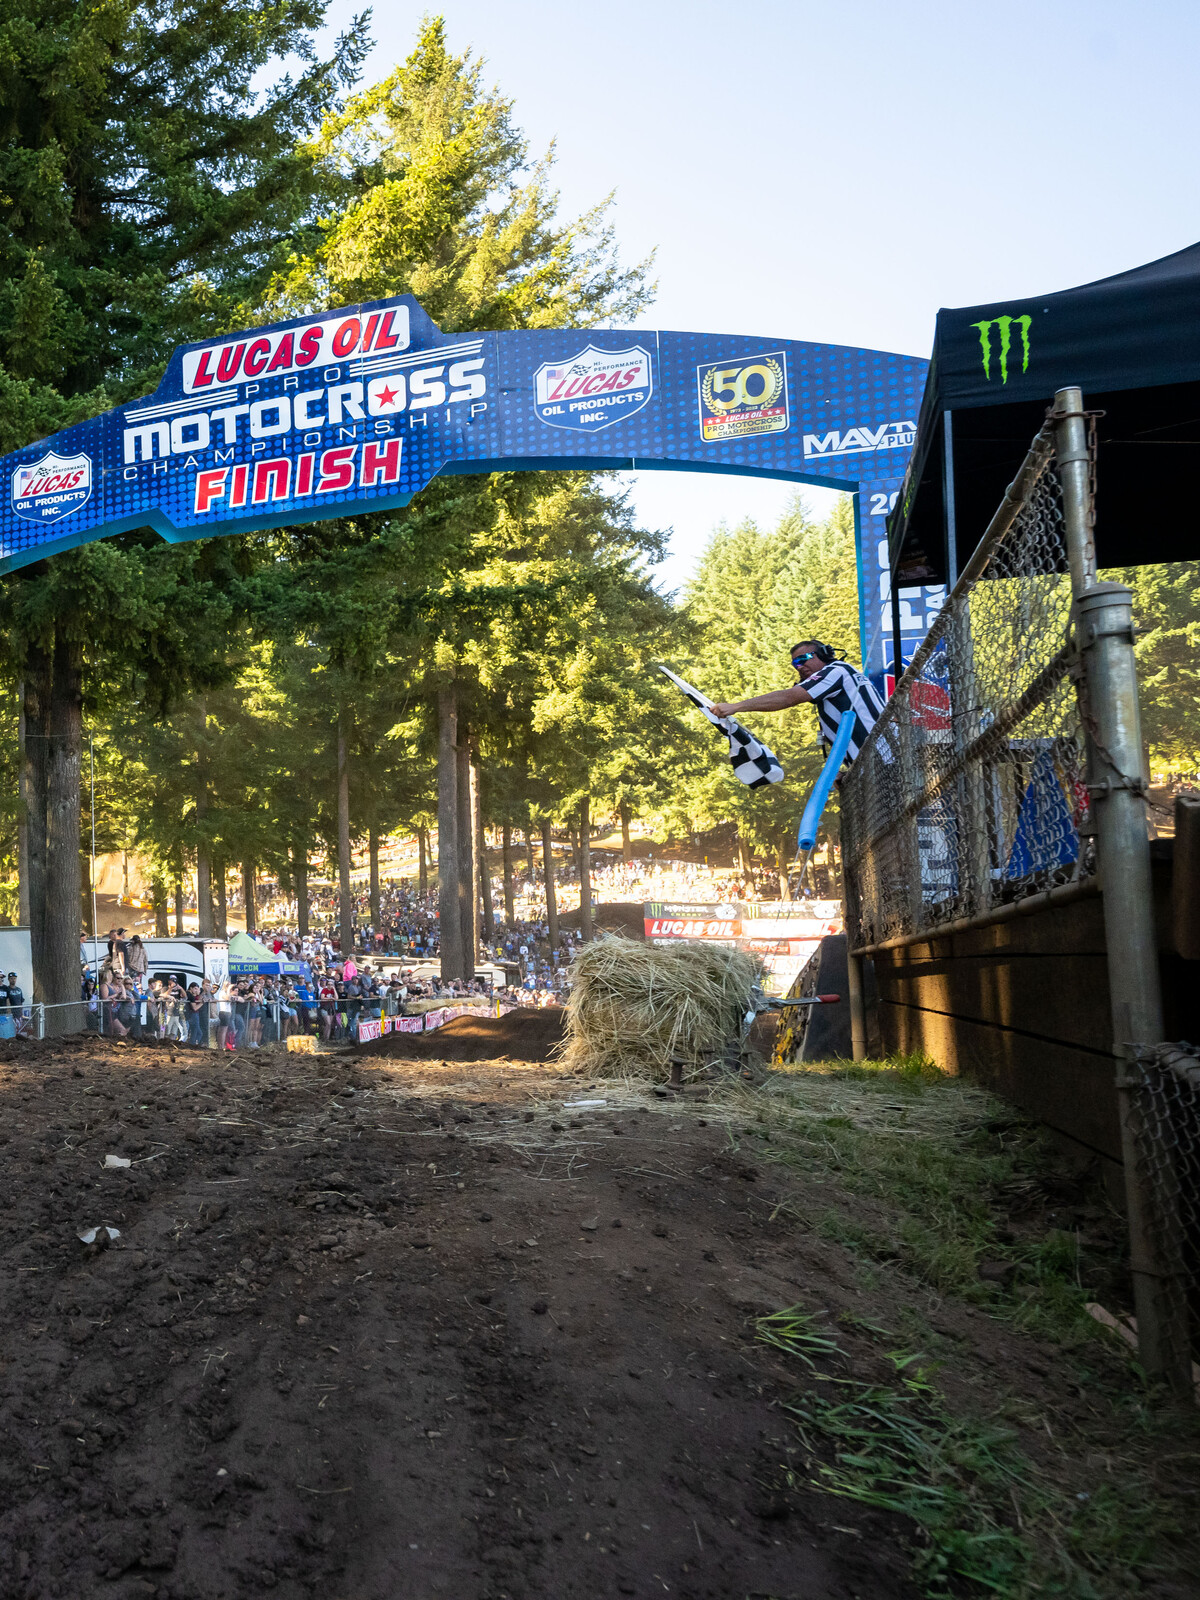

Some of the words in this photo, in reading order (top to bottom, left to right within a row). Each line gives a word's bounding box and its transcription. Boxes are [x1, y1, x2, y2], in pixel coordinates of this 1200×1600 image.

[192, 326, 324, 389] LUCAS
[331, 310, 399, 358] OIL
[593, 359, 644, 372] PERFORMANCE
[245, 367, 341, 398] PRO
[547, 366, 641, 401] LUCAS
[713, 364, 777, 410] 50
[123, 357, 487, 465] MOTOCROSS
[542, 405, 566, 417] OIL
[569, 391, 645, 413] PRODUCTS
[579, 411, 609, 424] INC.
[706, 424, 725, 433] PRO
[727, 415, 783, 430] MOTOCROSS
[725, 412, 750, 422] LUCAS
[750, 410, 763, 419] OIL
[717, 424, 773, 437] CHAMPIONSHIP
[887, 433, 915, 447] PLU
[123, 402, 488, 481] CHAMPIONSHIP
[20, 470, 85, 497] LUCAS
[193, 437, 404, 514] FINISH
[16, 501, 33, 510] OIL
[35, 491, 86, 507] PRODUCTS
[41, 507, 61, 517] INC.
[651, 920, 705, 936] LUCAS
[706, 921, 734, 936] OIL
[359, 1020, 391, 1040] MOTOSPRT
